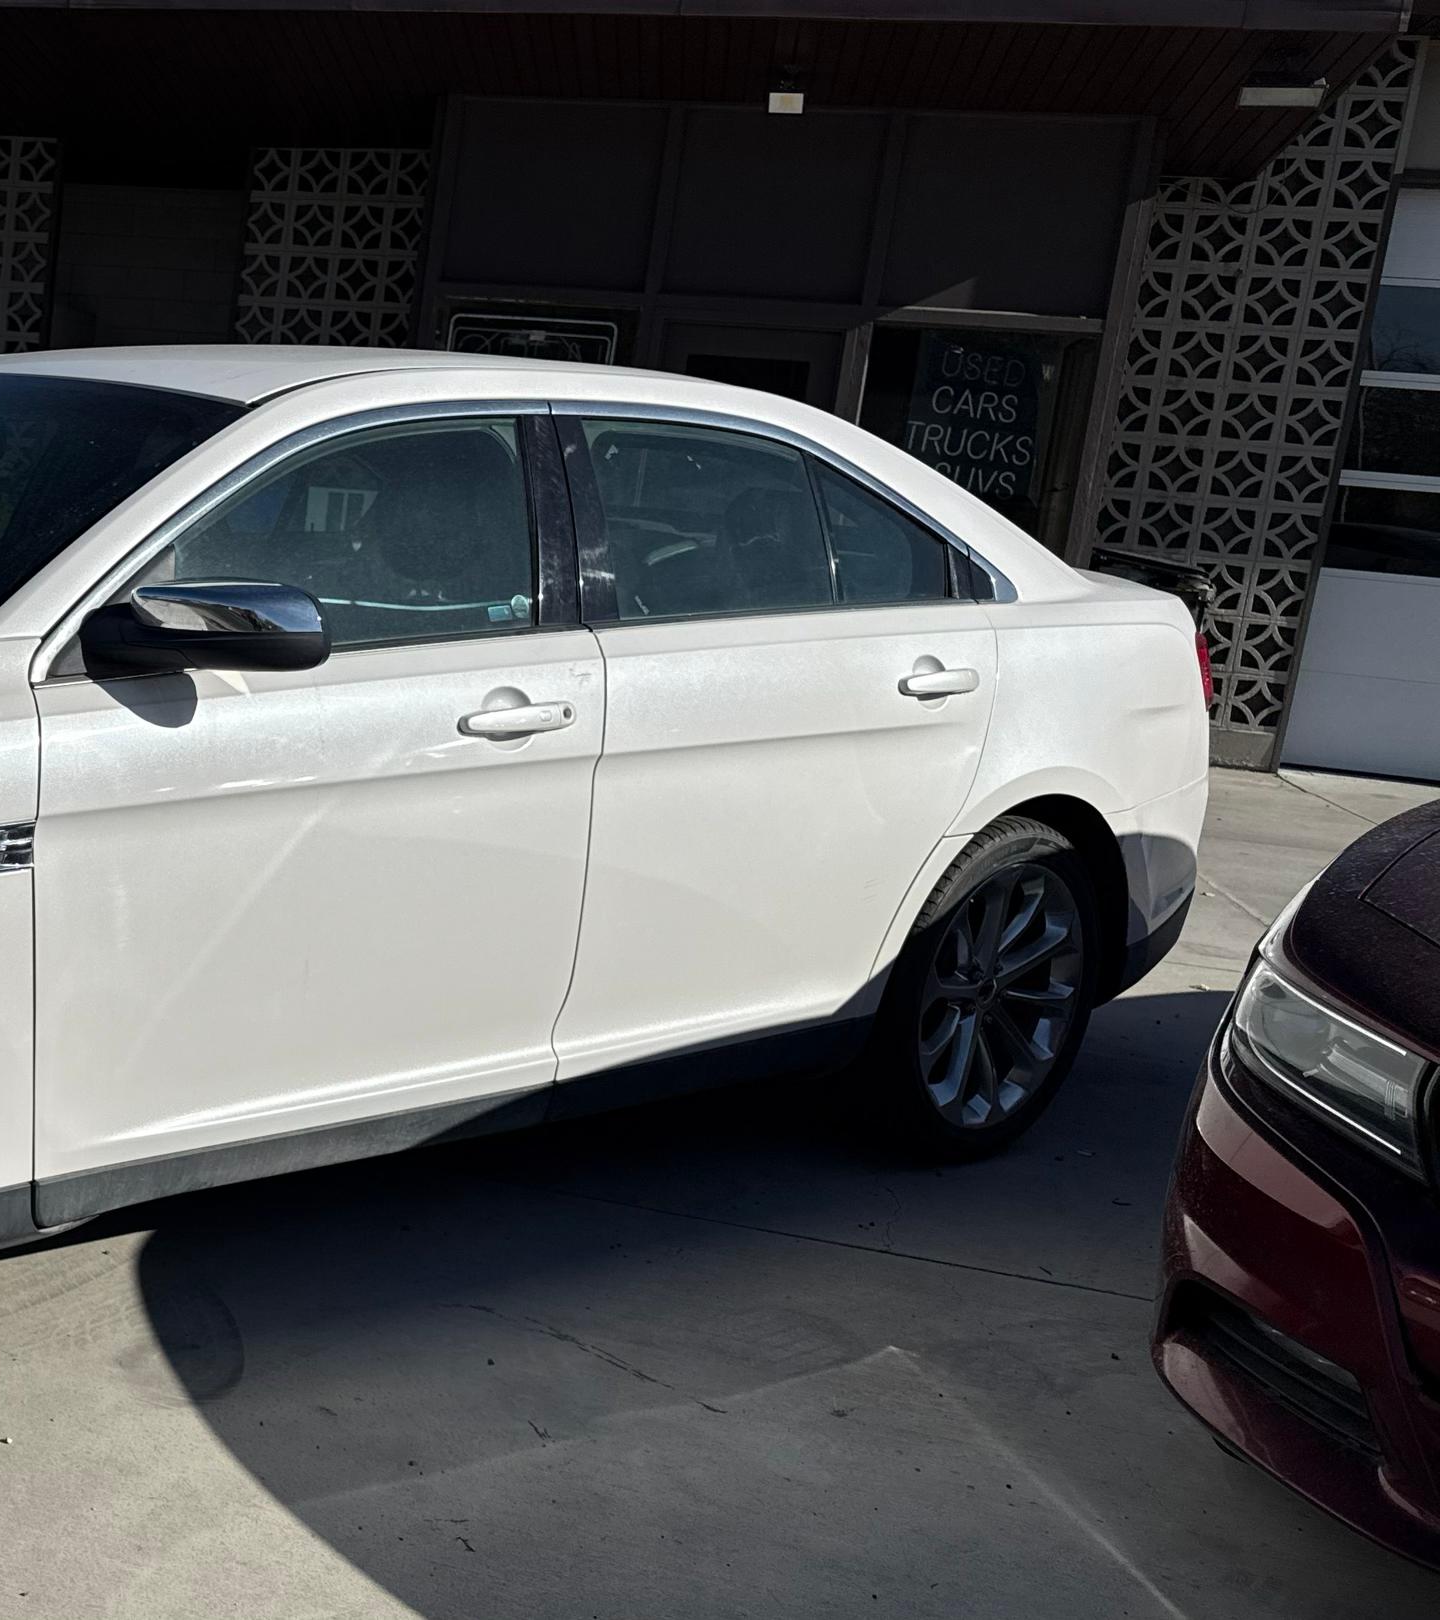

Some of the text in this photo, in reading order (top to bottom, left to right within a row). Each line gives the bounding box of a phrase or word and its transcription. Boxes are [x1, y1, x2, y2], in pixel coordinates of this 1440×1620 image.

[941, 351, 1026, 388] USED
[931, 385, 1019, 424] CARS
[906, 420, 1034, 466] TRUCKS
